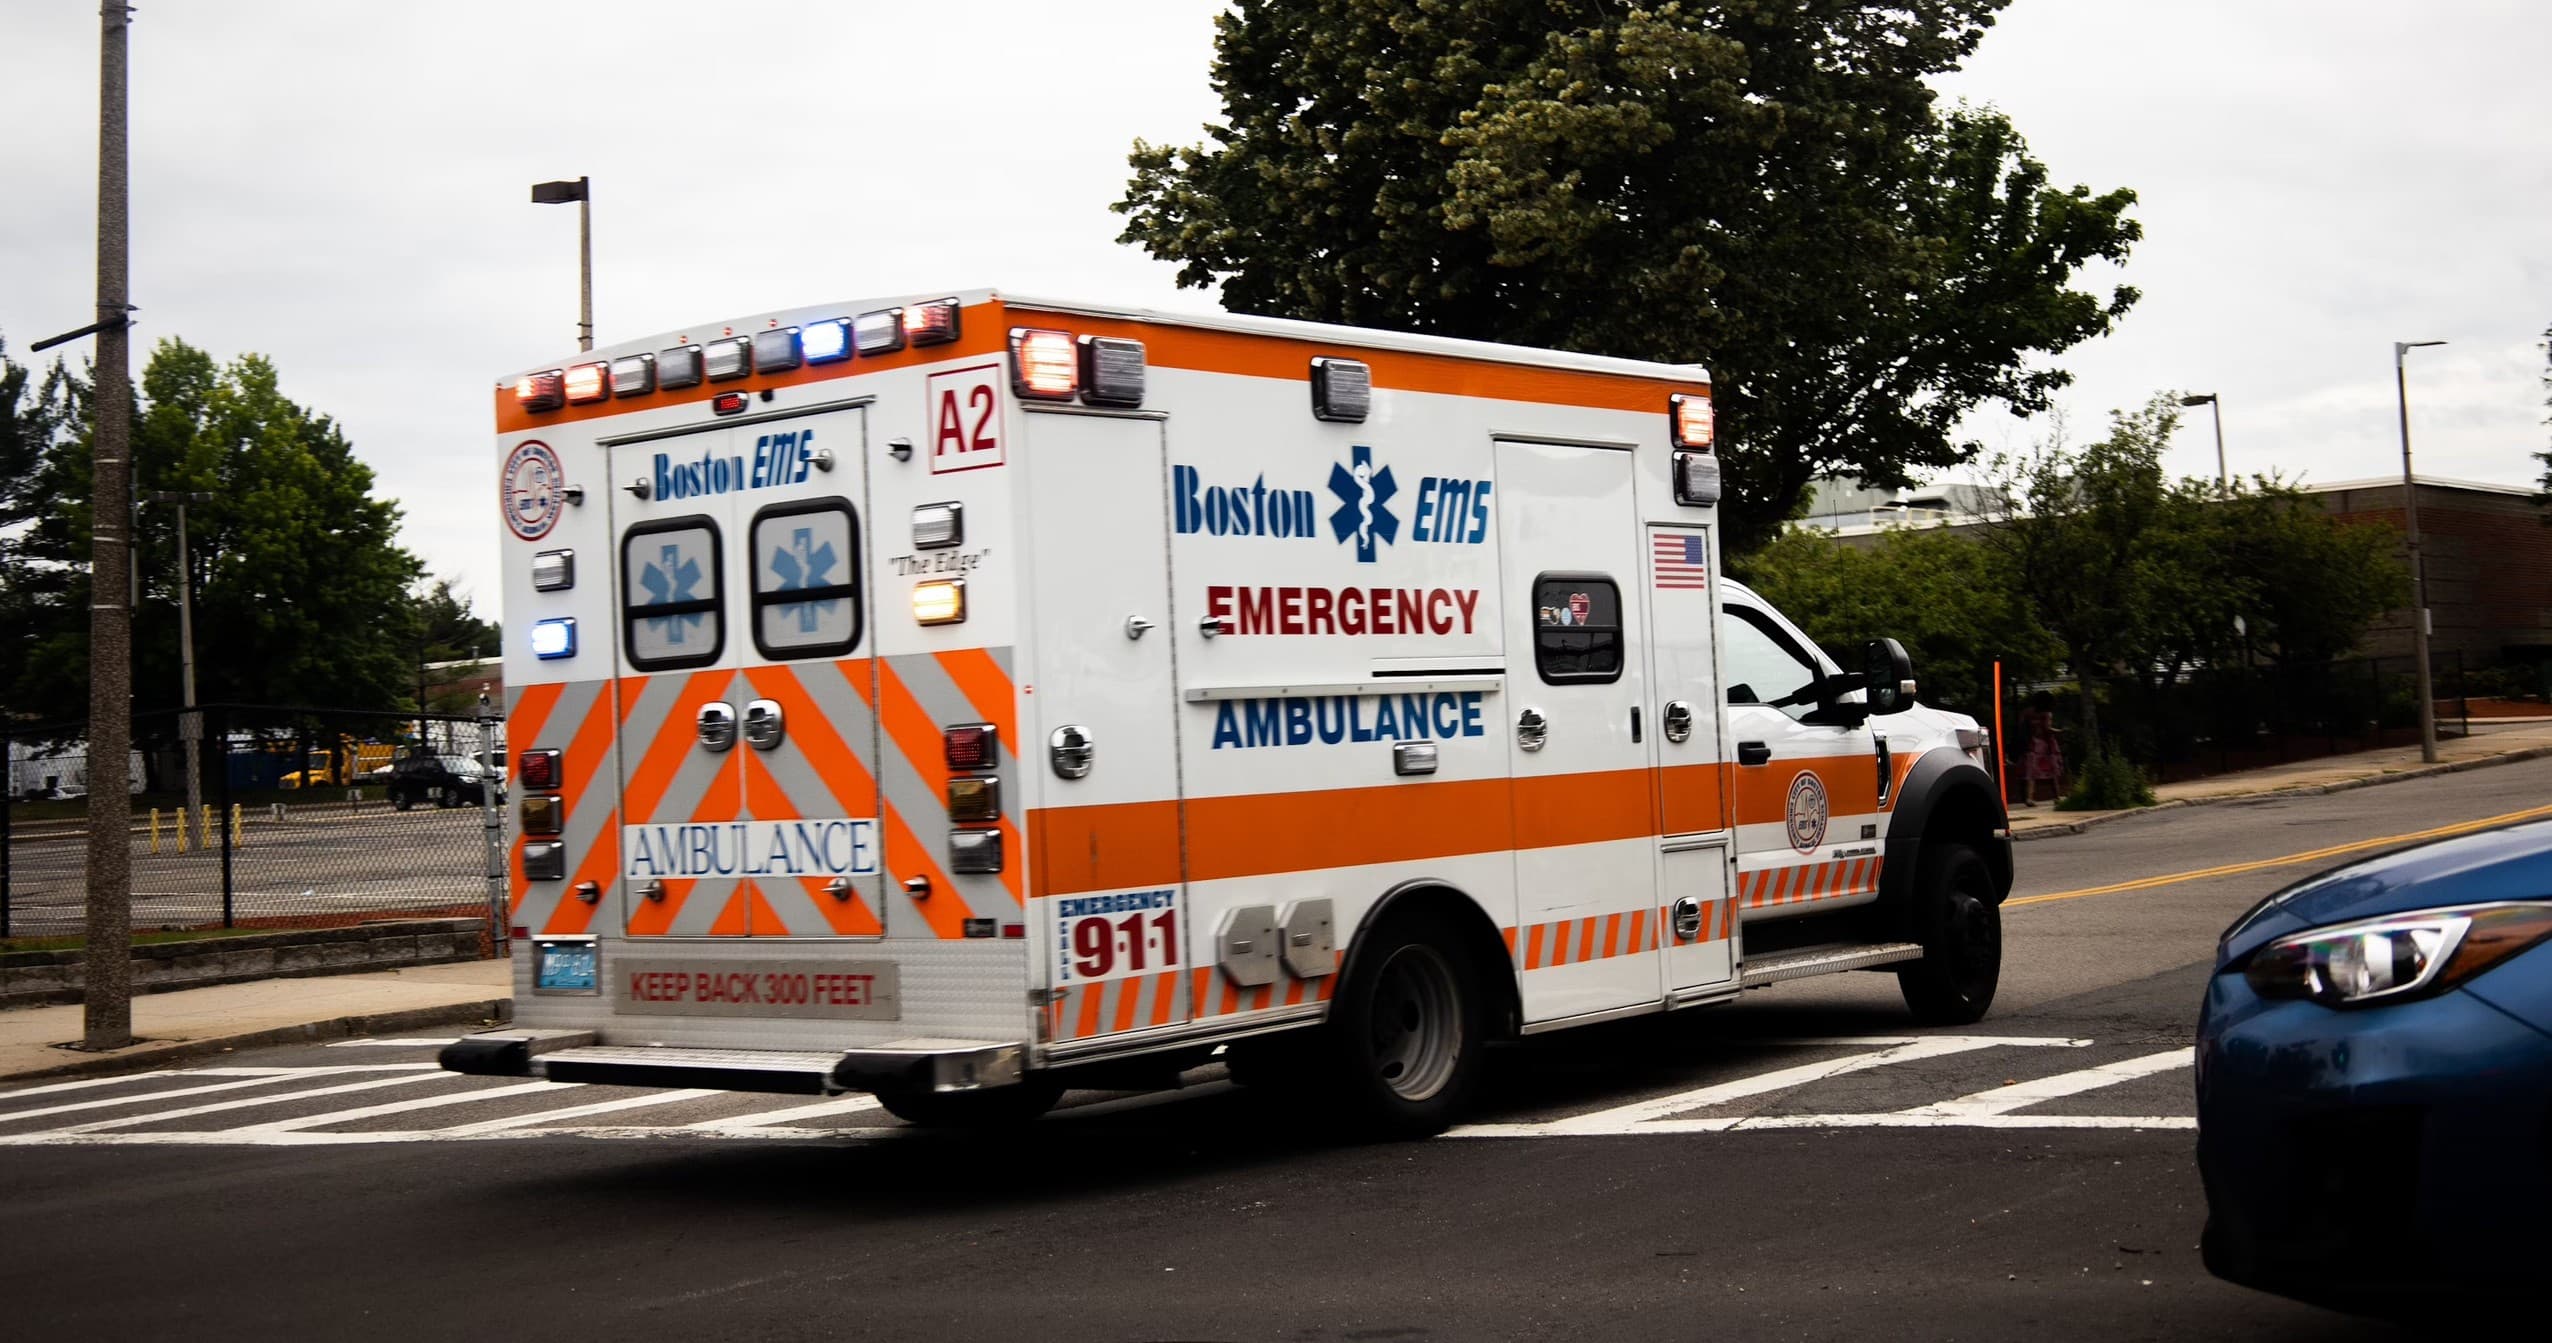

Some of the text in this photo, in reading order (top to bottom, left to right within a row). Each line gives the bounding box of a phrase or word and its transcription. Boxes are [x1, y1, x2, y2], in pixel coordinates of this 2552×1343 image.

[937, 384, 996, 456] A2
[654, 447, 744, 502] Boston
[1172, 464, 1316, 539] Boston
[1207, 585, 1480, 636] EMERGENCY
[1211, 691, 1485, 750] AMBULANCE
[630, 821, 875, 876] AMBULANCE
[1059, 890, 1176, 917] EMERGENCY
[629, 972, 875, 1005] KEEP BACK 300 FEET
